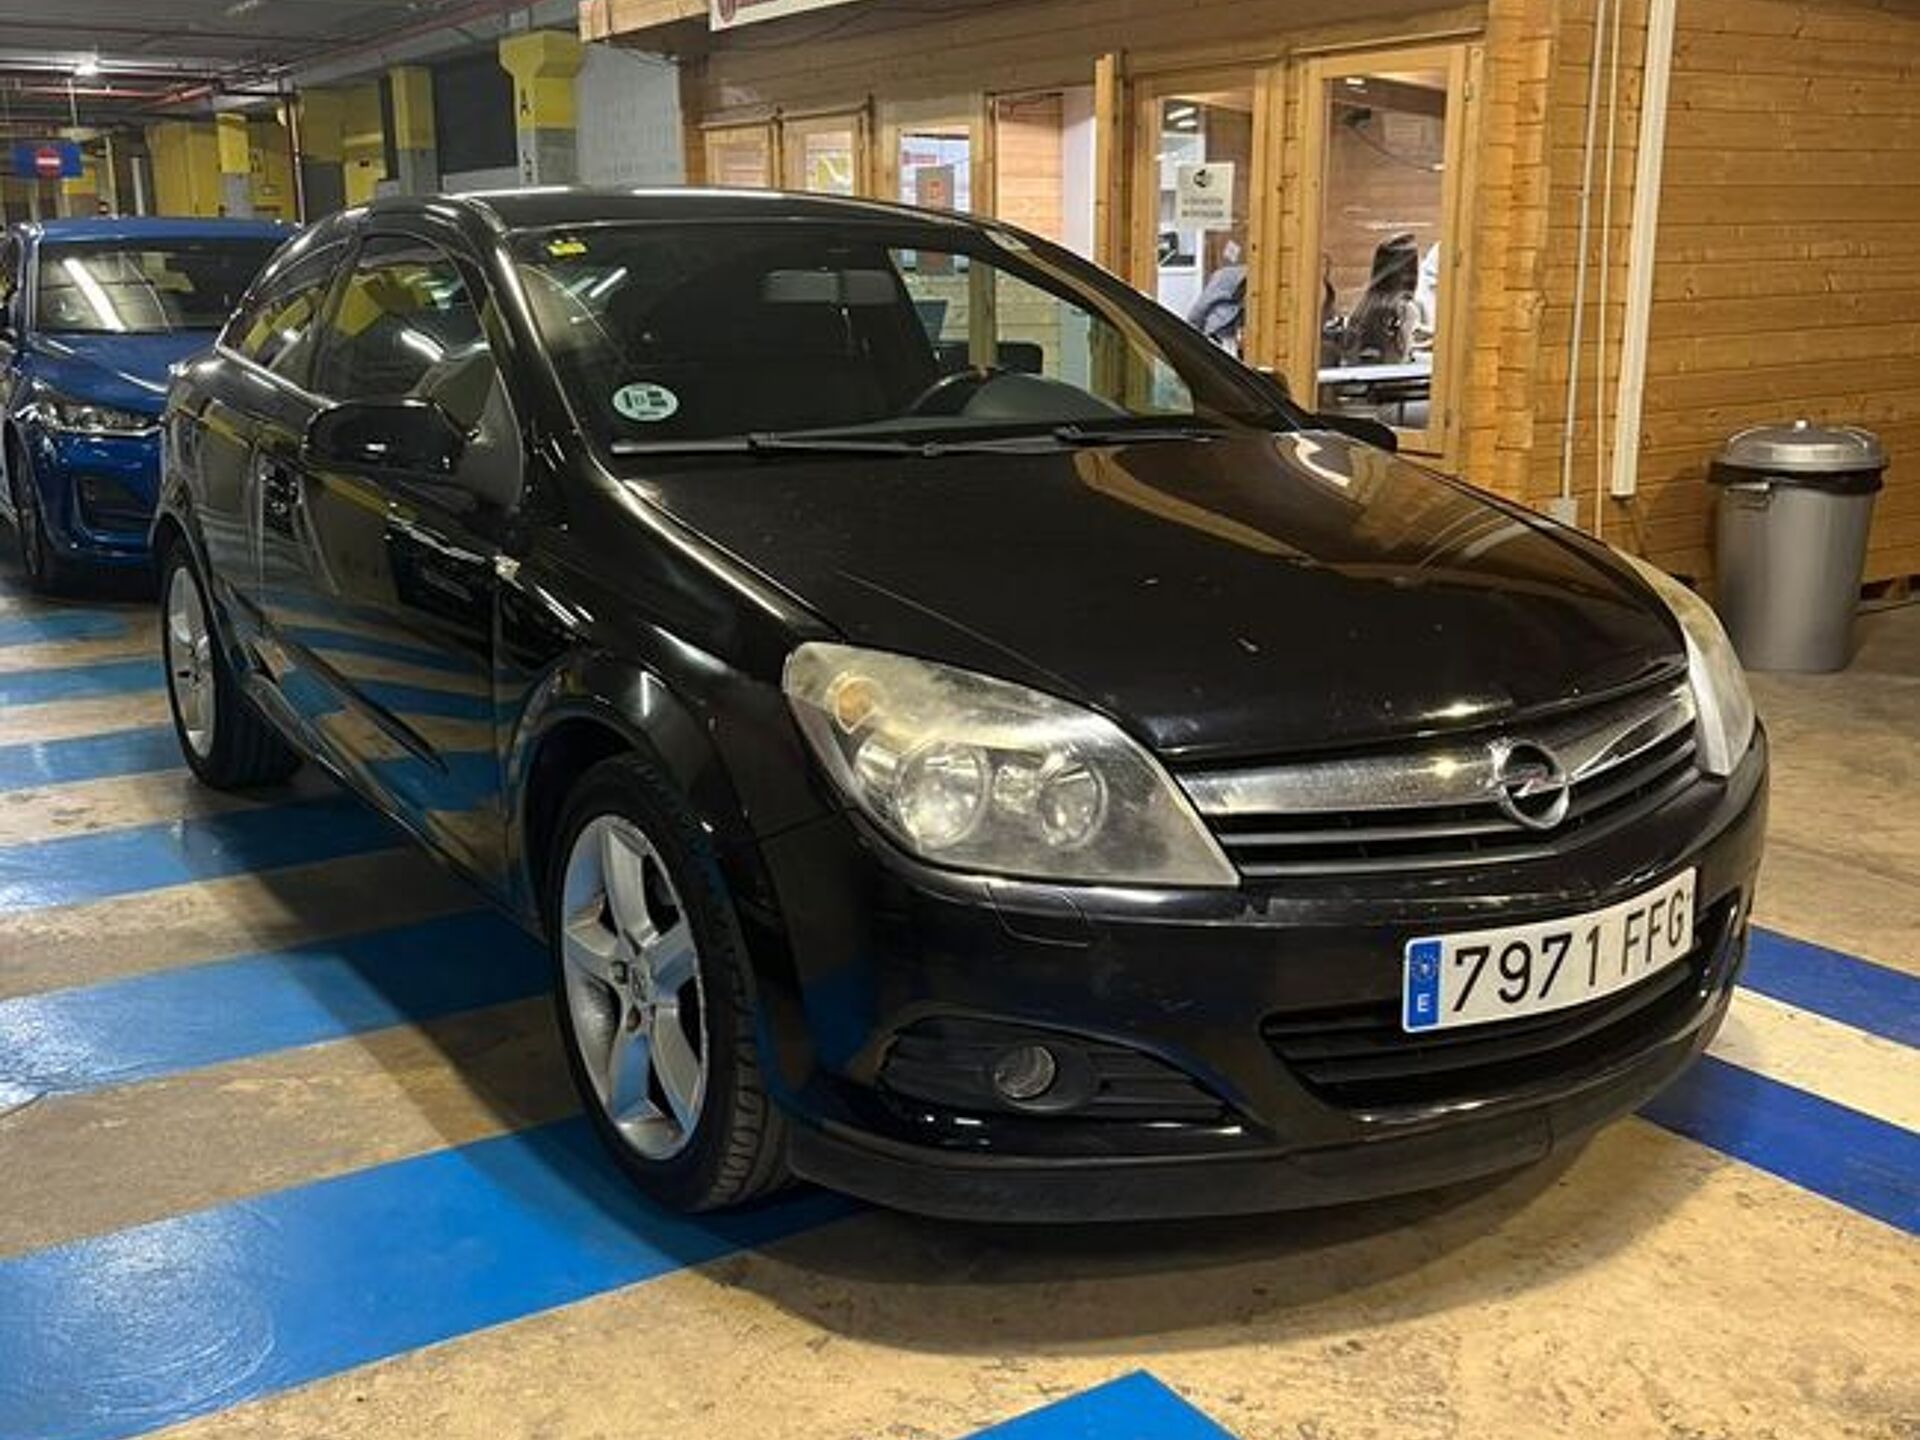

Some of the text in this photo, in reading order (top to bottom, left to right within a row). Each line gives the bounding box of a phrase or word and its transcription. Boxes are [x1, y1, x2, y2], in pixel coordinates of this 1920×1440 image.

[1452, 889, 1685, 1013] 7971 FFG
[1416, 993, 1431, 1013] E
